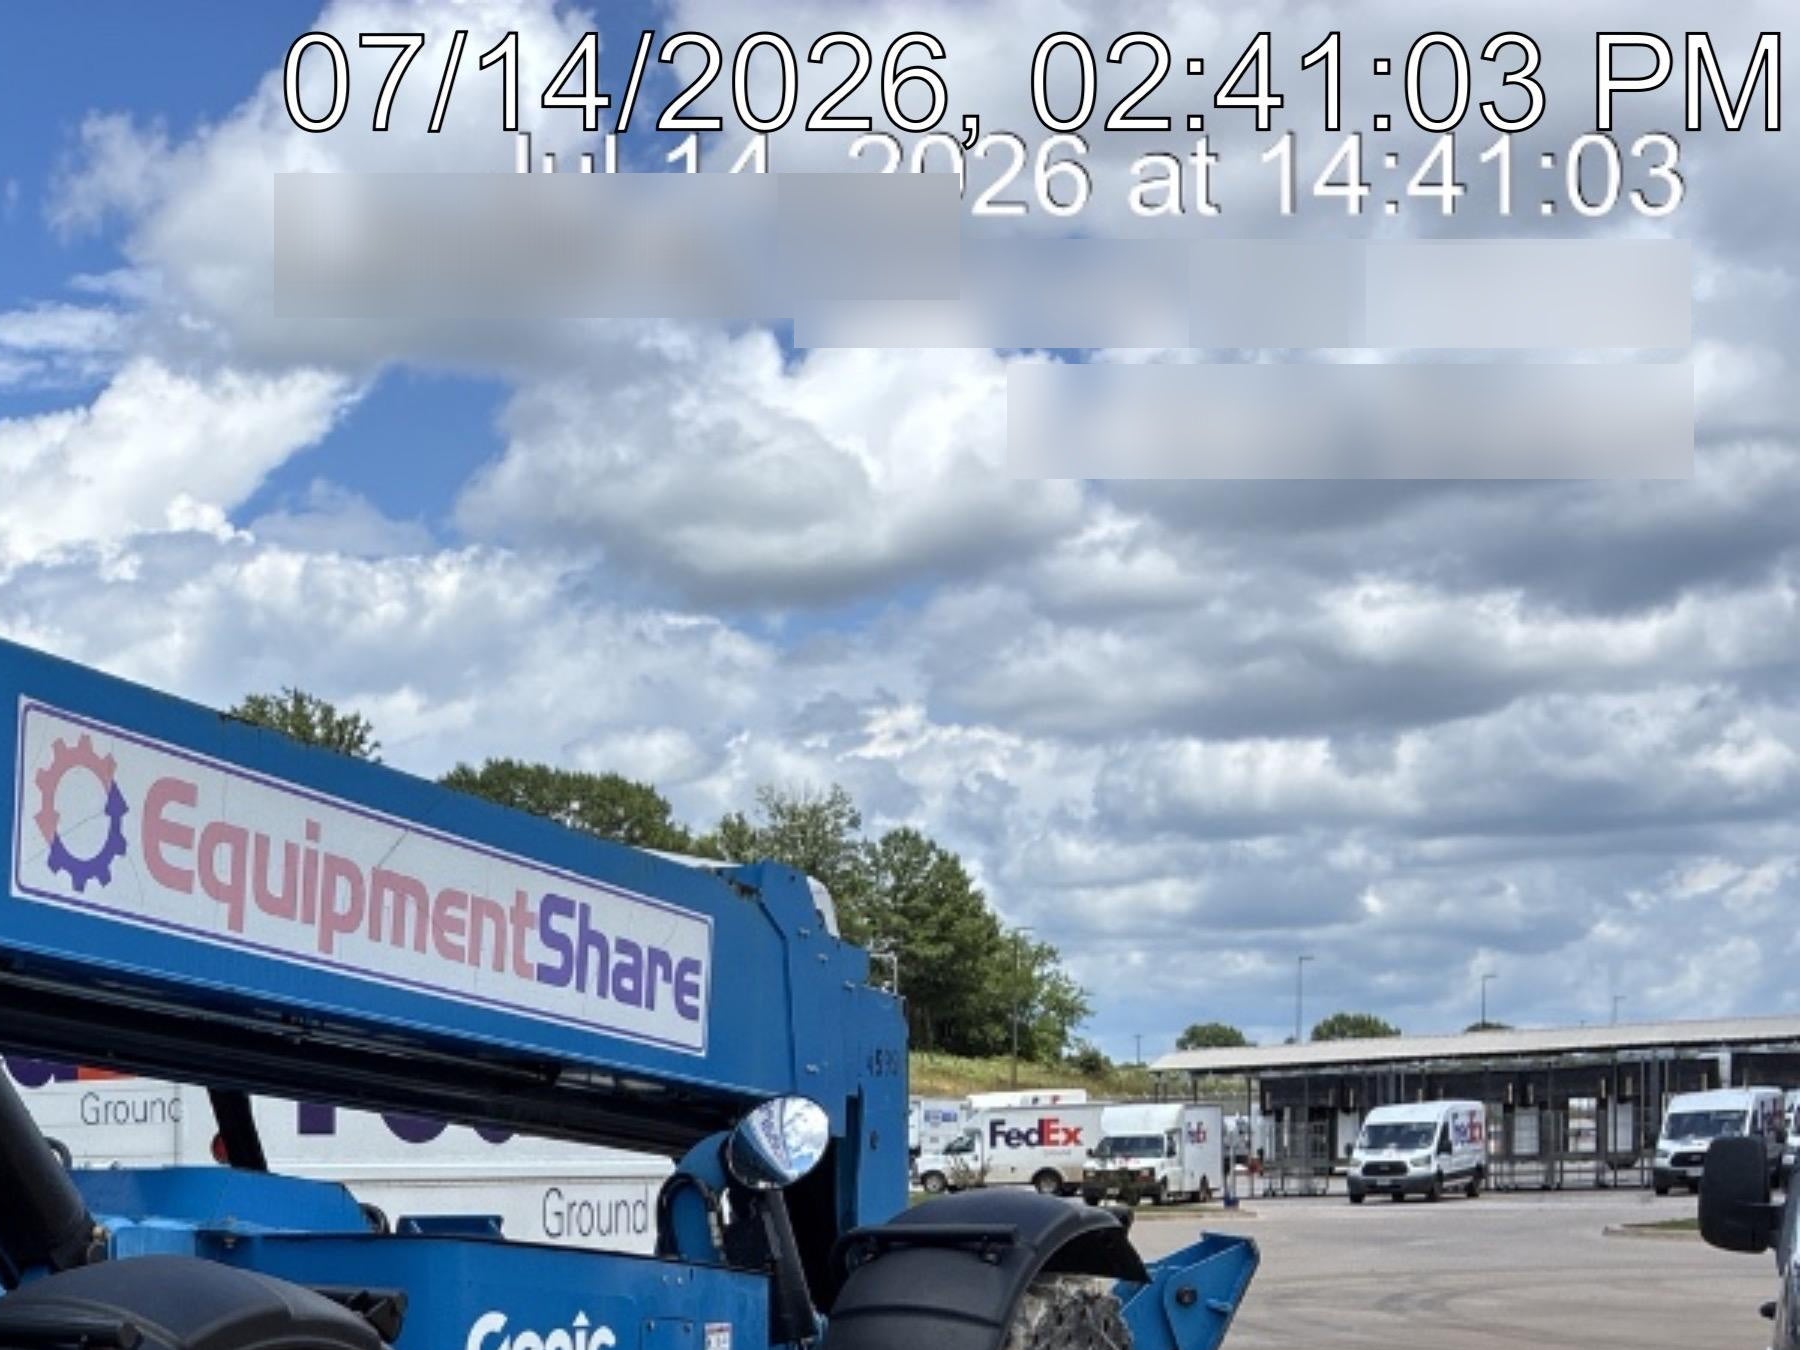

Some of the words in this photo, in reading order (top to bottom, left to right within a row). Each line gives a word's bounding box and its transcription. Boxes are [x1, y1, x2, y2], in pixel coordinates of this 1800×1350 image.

[140, 775, 702, 1022] EquipmentShare
[989, 1118, 1084, 1148] FedEx
[542, 1184, 648, 1238] Ground
